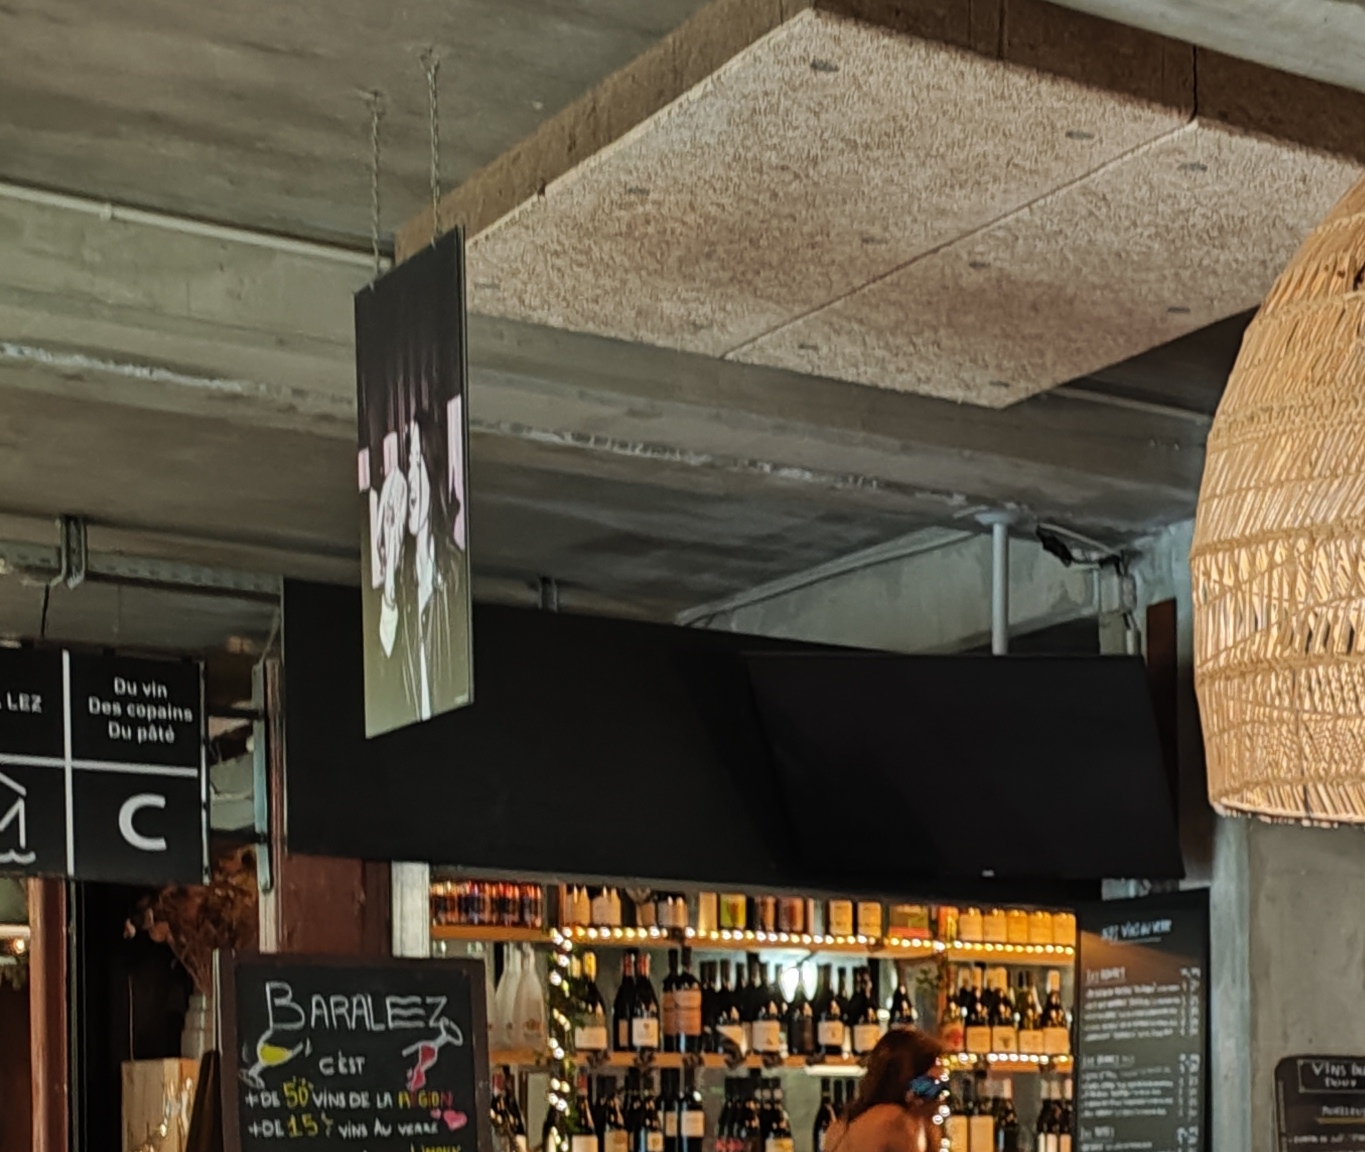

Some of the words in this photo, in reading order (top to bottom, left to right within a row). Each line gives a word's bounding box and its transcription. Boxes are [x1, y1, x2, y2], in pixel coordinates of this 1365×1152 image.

[114, 676, 138, 696] Du
[142, 679, 168, 699] vin
[7, 691, 43, 713] LEZ
[88, 695, 122, 717] Des
[127, 703, 193, 722] copains
[108, 720, 132, 741] Du
[137, 724, 176, 744] pâté
[118, 793, 167, 851] C
[376, 1092, 393, 1108] LA
